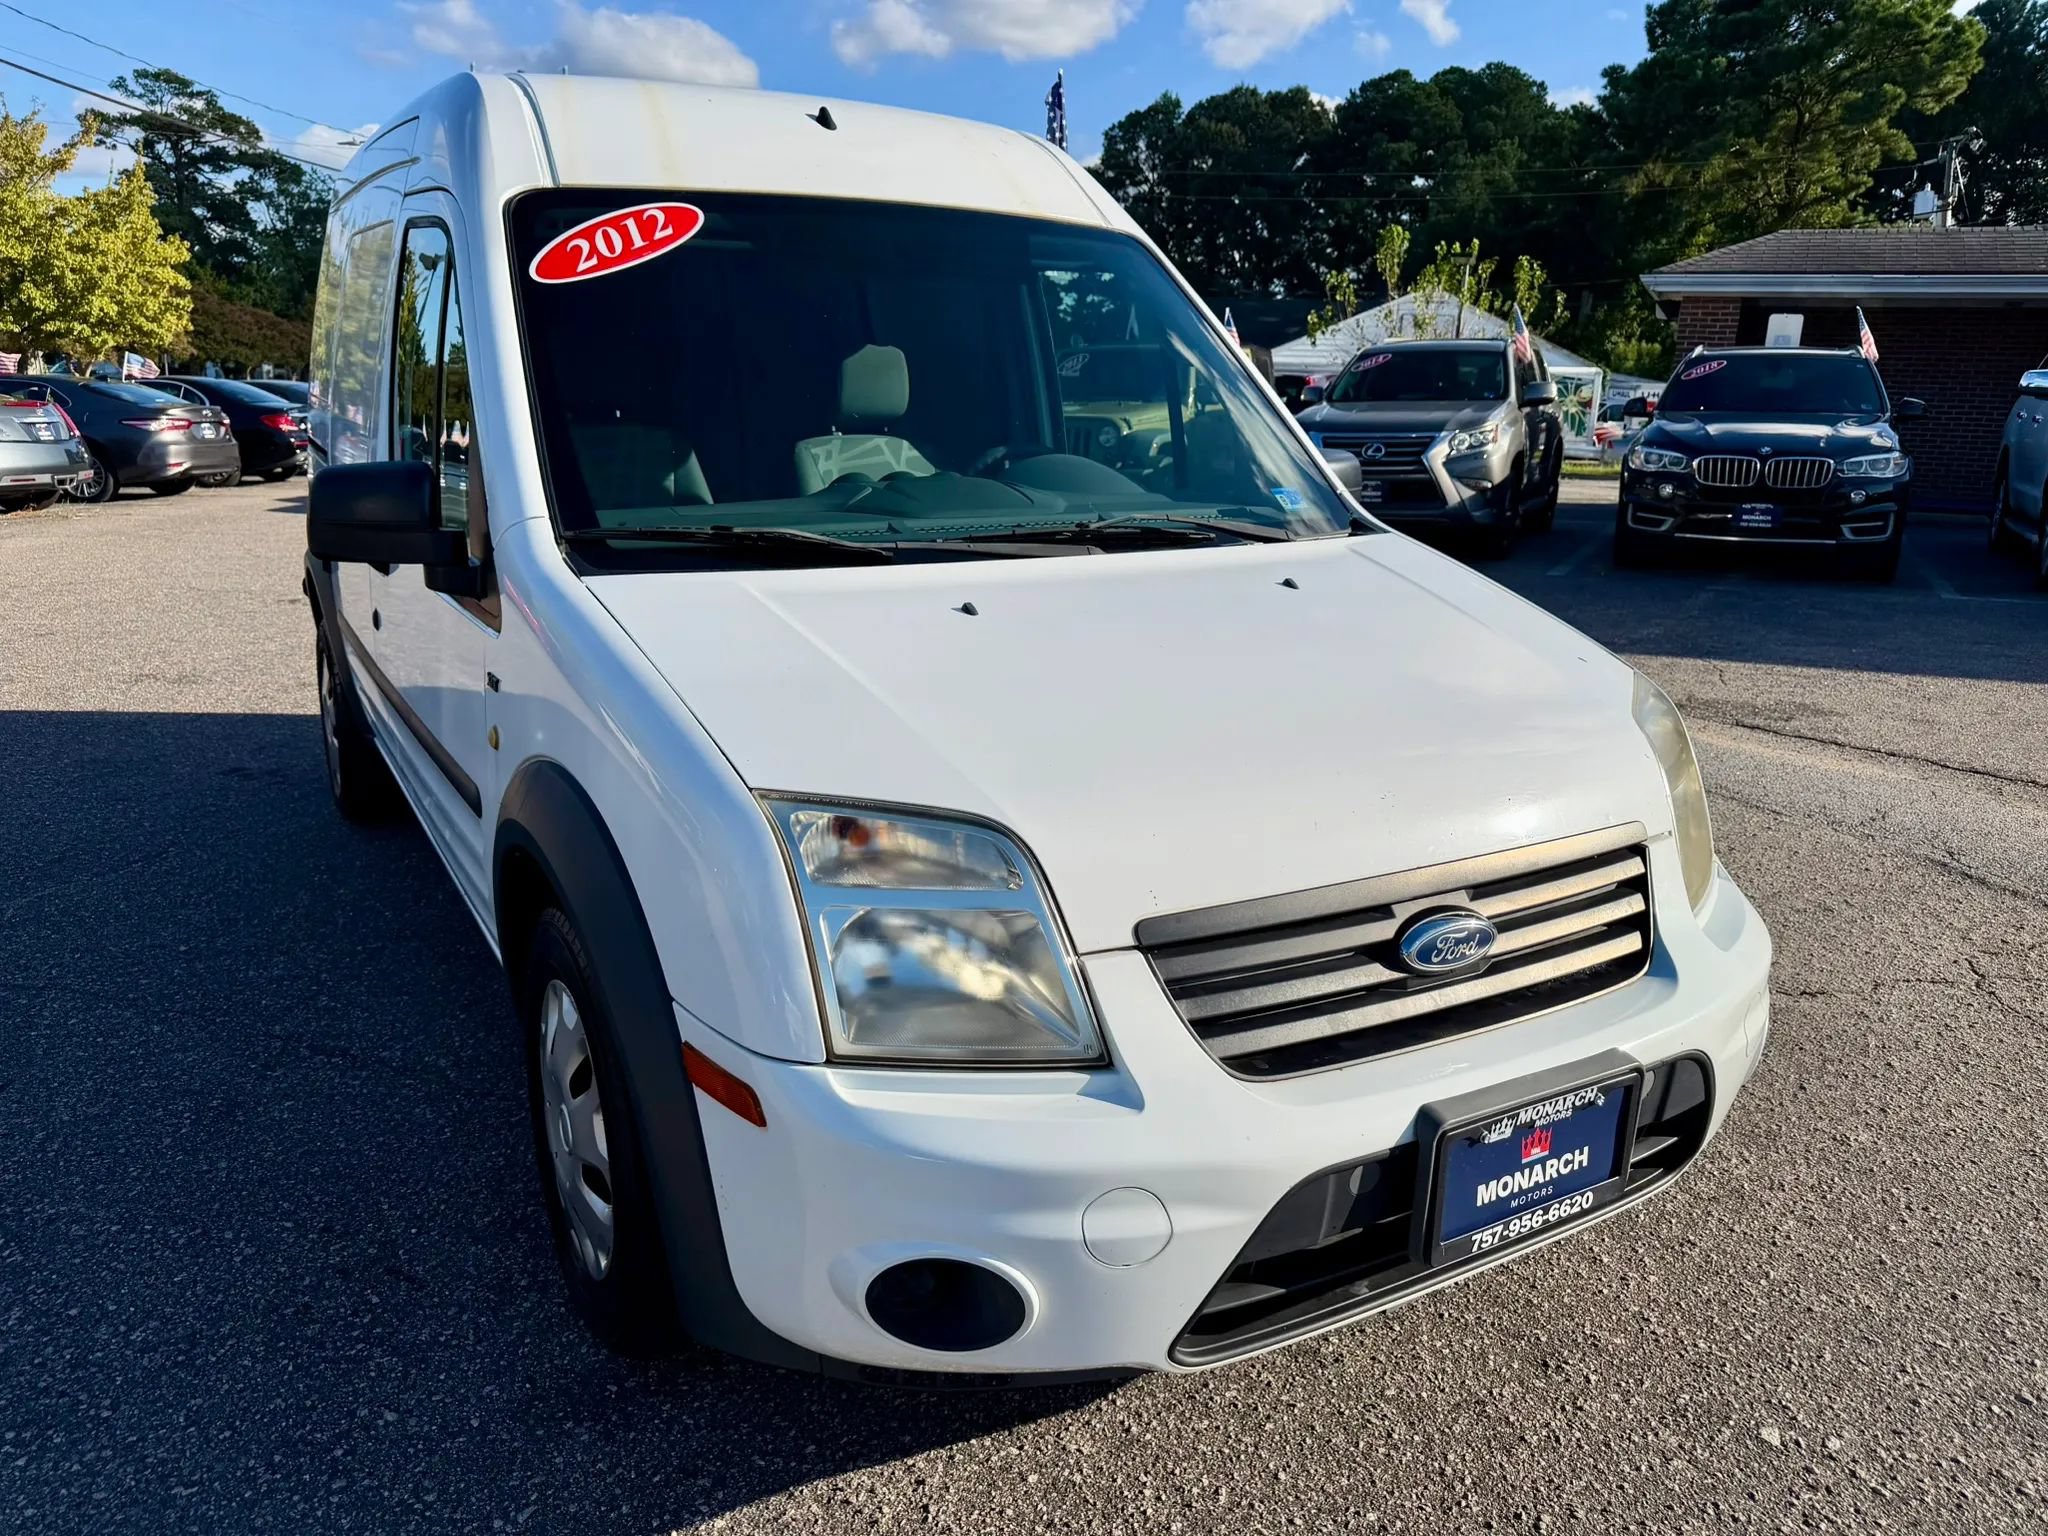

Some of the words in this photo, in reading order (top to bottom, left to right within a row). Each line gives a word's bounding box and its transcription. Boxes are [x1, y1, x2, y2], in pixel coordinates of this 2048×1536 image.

[566, 208, 674, 273] 2012
[1431, 930, 1480, 963] Ford
[1516, 1087, 1598, 1126] MONARCH
[1534, 1108, 1573, 1128] MOTORS
[1476, 1145, 1590, 1207] MONARCH
[1510, 1185, 1554, 1209] MOTORS
[1471, 1190, 1594, 1253] 757-956-6620
